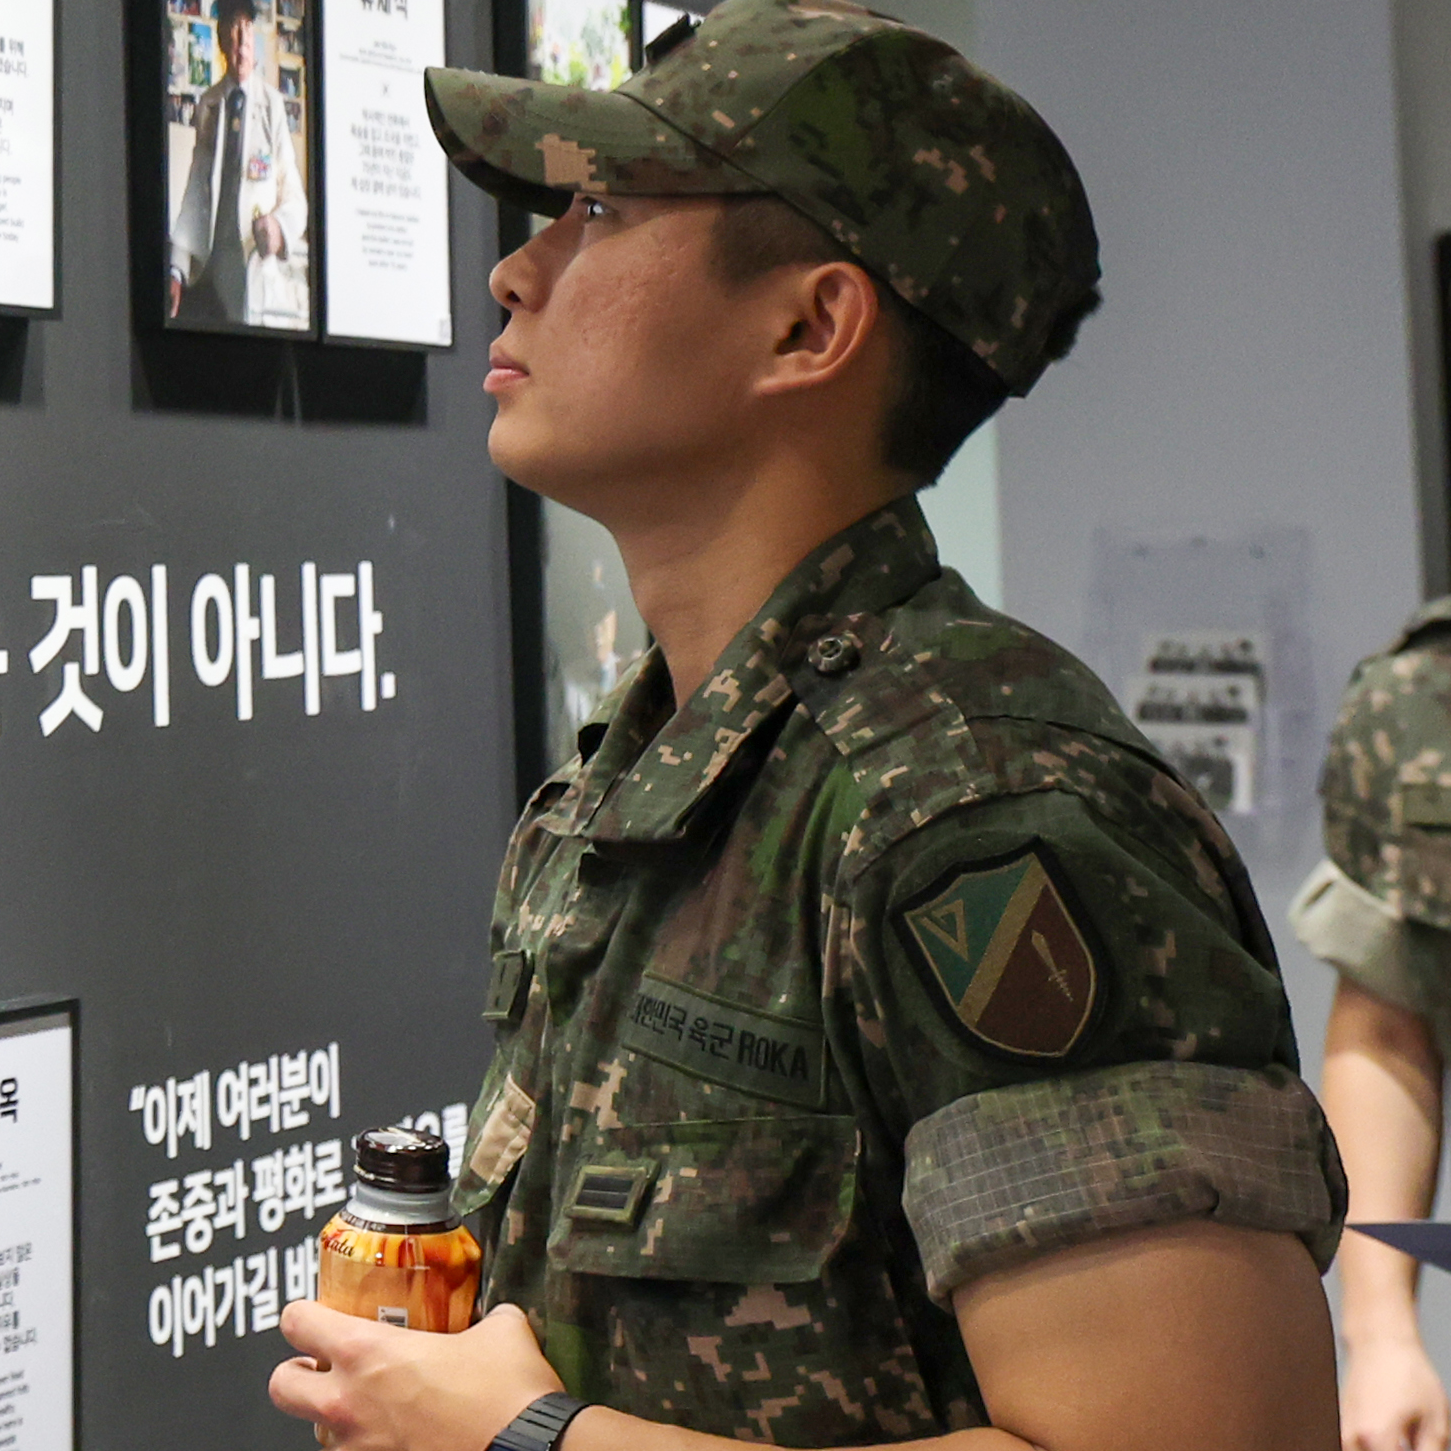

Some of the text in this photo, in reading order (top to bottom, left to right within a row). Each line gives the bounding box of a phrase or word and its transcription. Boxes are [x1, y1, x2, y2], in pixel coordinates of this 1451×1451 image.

[29, 564, 170, 737] 것이
[191, 560, 396, 721] 아니다.
[217, 1042, 340, 1141] 여러분이
[688, 1016, 736, 1060] 육군
[737, 1029, 809, 1081] ROKA
[146, 1159, 249, 1263] 존중과
[252, 1139, 348, 1235] 평화로
[149, 1244, 280, 1358] 이어가길
